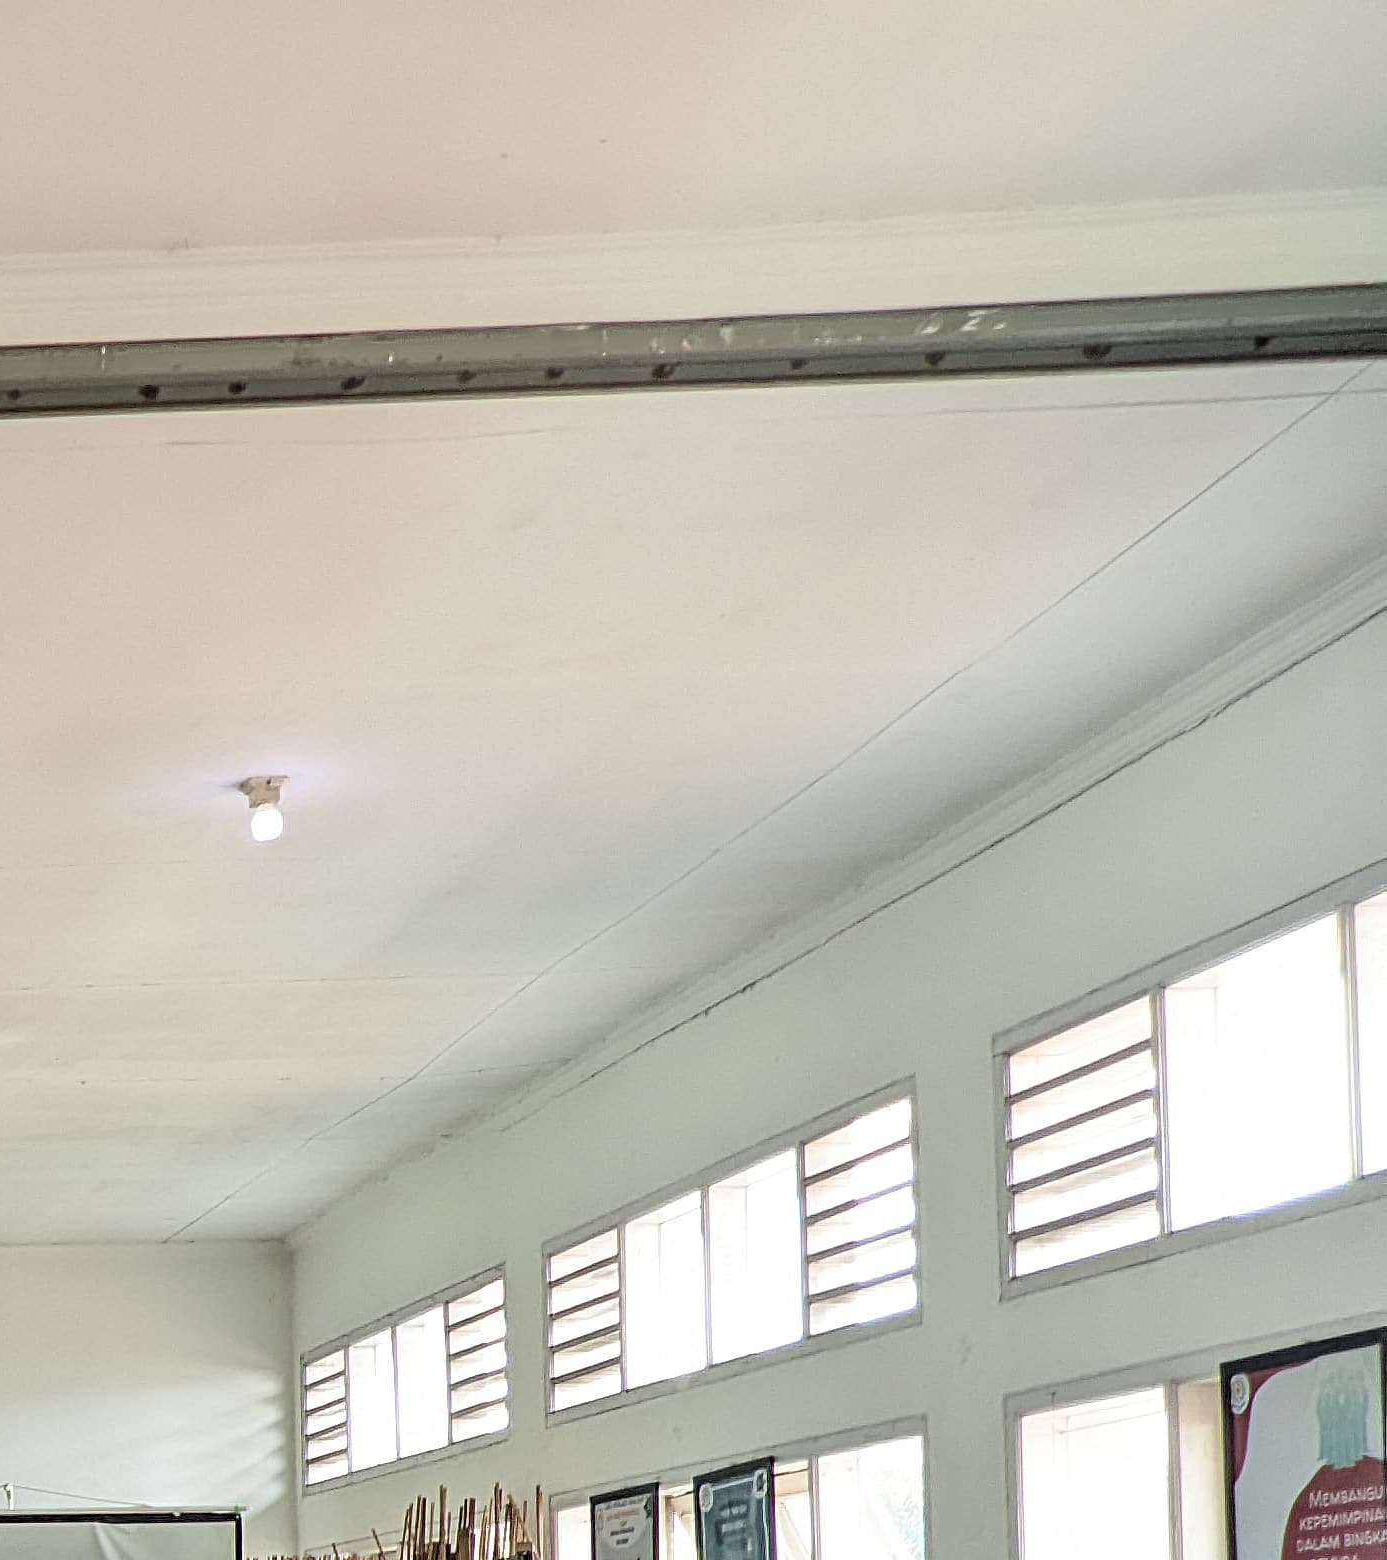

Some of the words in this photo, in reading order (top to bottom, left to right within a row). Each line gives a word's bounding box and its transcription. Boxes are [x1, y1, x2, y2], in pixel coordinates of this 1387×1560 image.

[1309, 1485, 1384, 1509] MEMBANGU
[1298, 1507, 1386, 1531] KEPEMIMPINA
[1296, 1533, 1340, 1552] DALAM
[1344, 1529, 1387, 1547] BINGKA
